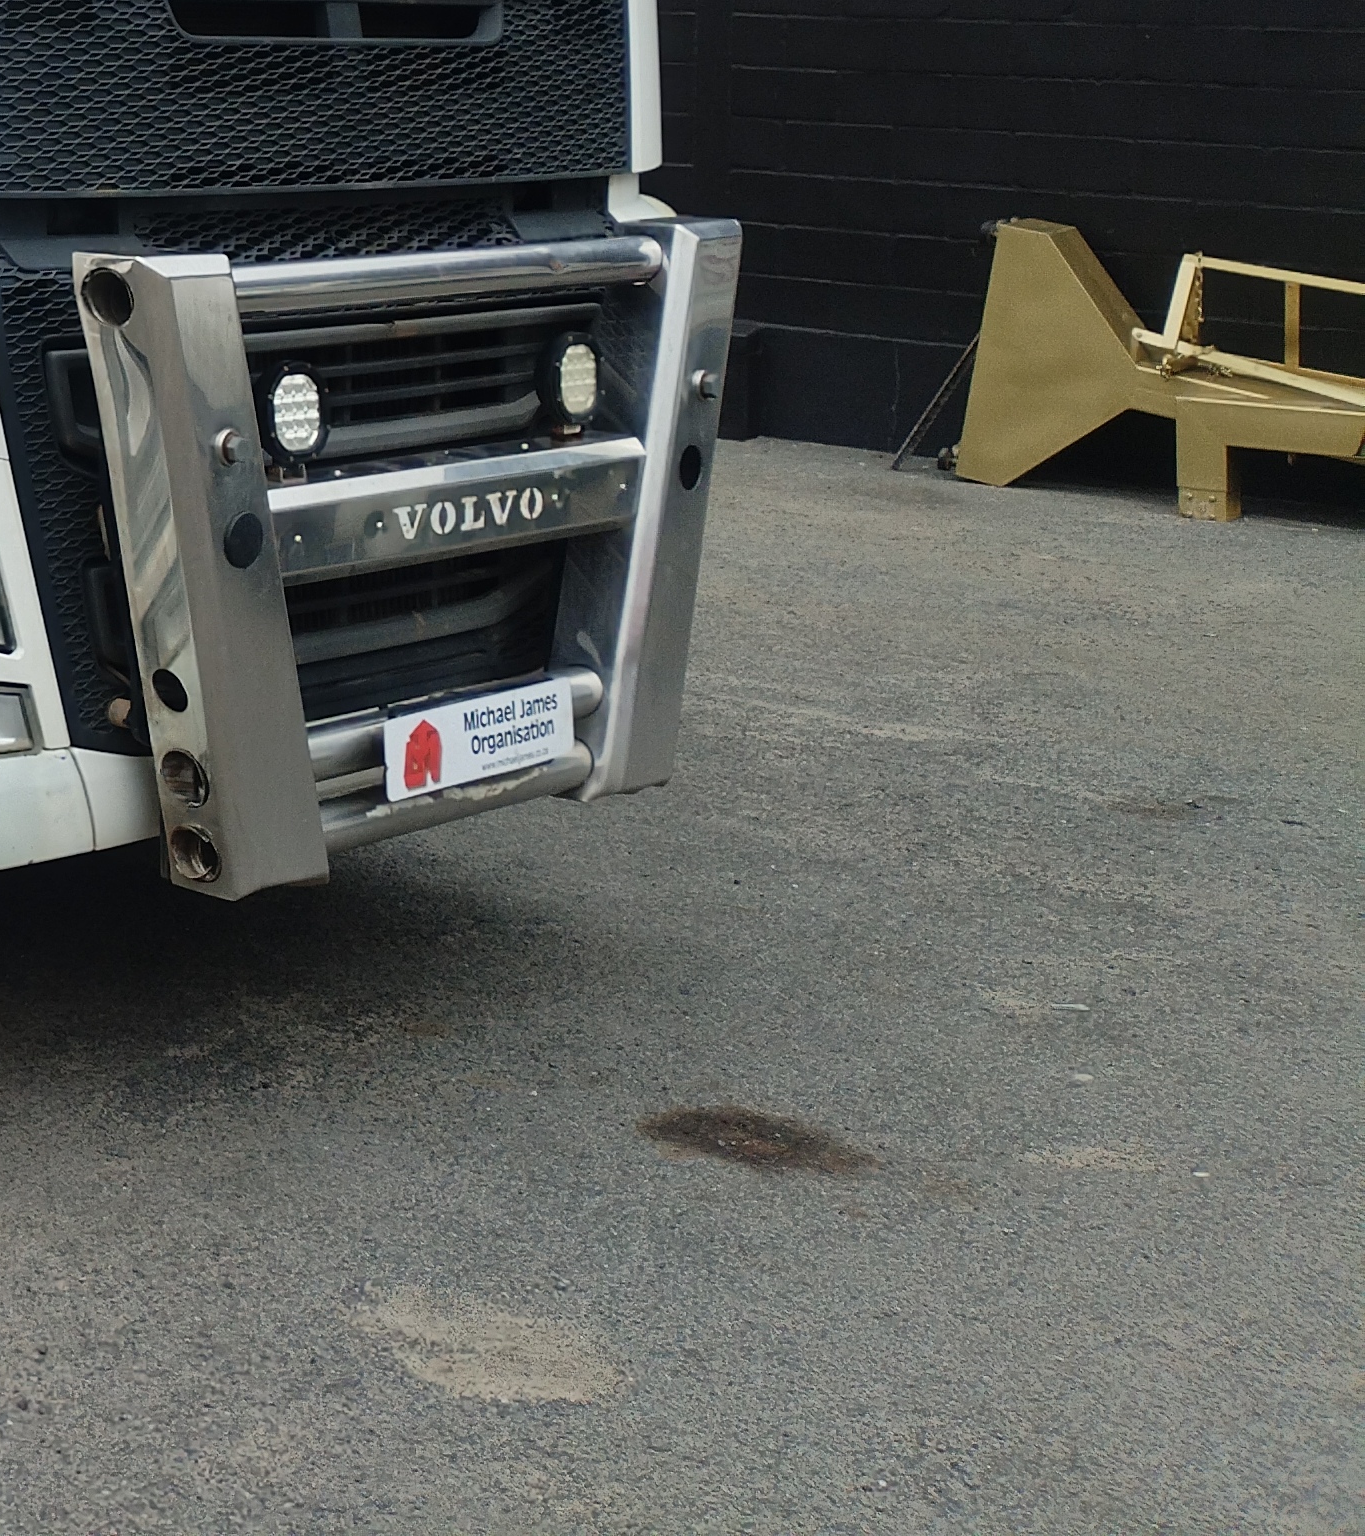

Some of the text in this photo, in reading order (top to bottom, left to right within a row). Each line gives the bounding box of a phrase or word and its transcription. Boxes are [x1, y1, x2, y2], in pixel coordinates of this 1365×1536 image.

[392, 487, 544, 540] VOLVO
[463, 694, 558, 732] Michael James
[471, 719, 555, 754] Organisation
